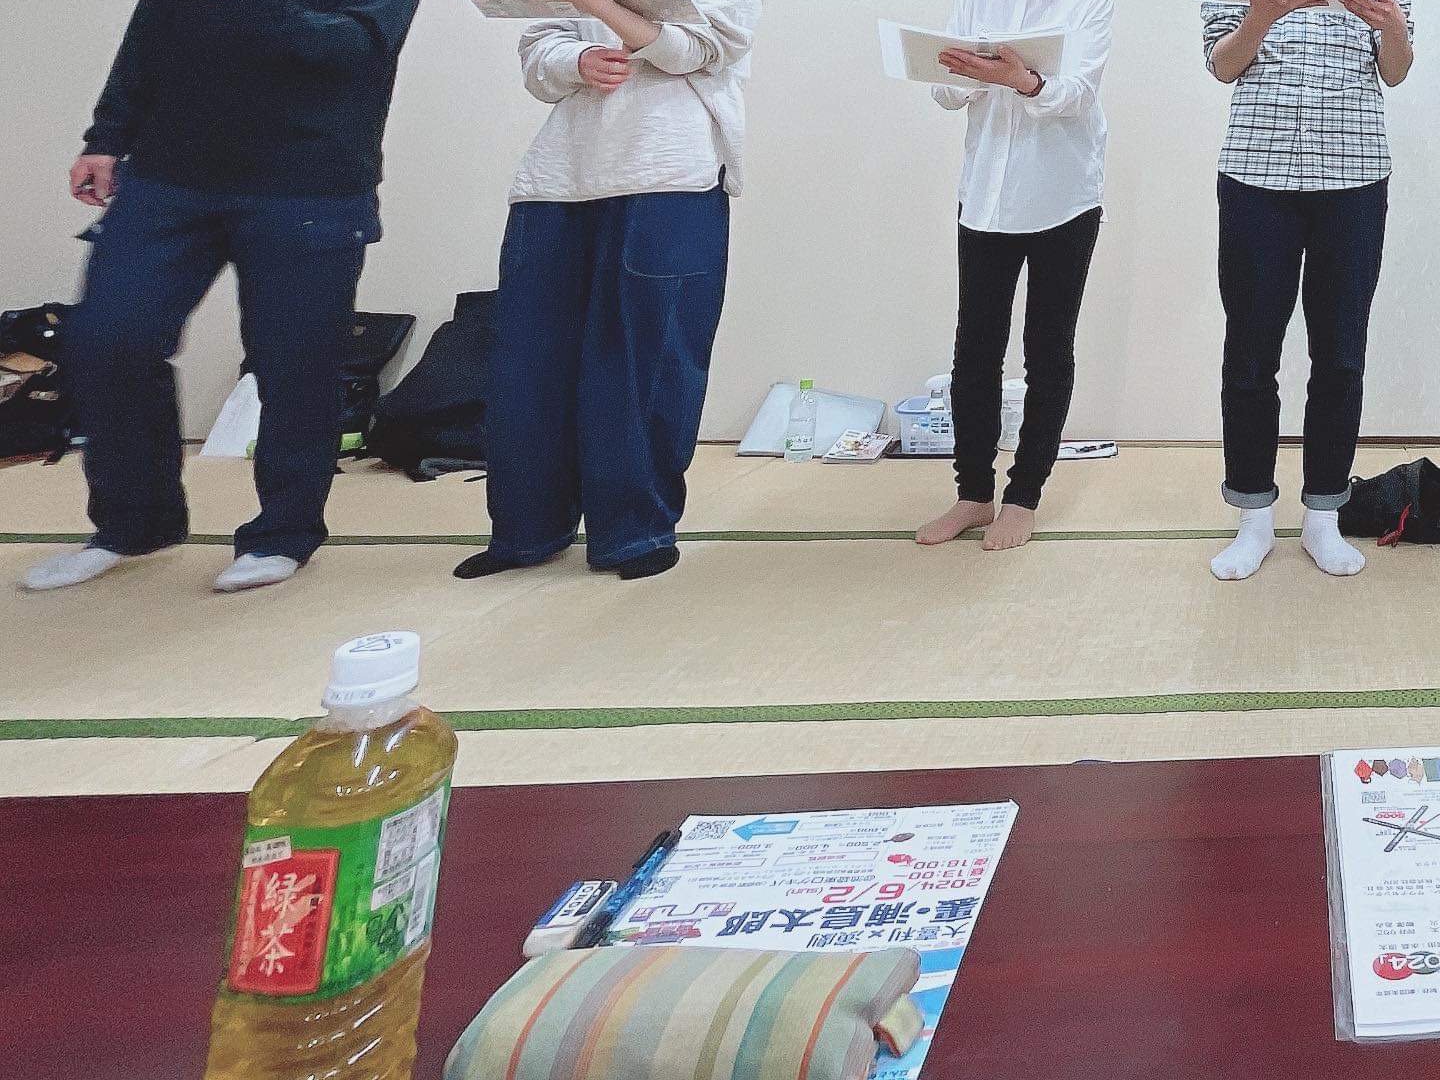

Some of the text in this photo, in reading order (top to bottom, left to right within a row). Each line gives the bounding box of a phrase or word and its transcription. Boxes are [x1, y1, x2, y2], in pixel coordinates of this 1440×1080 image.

[257, 872, 304, 977] 緑茶
[715, 897, 980, 937] 裏・浦島太郎
